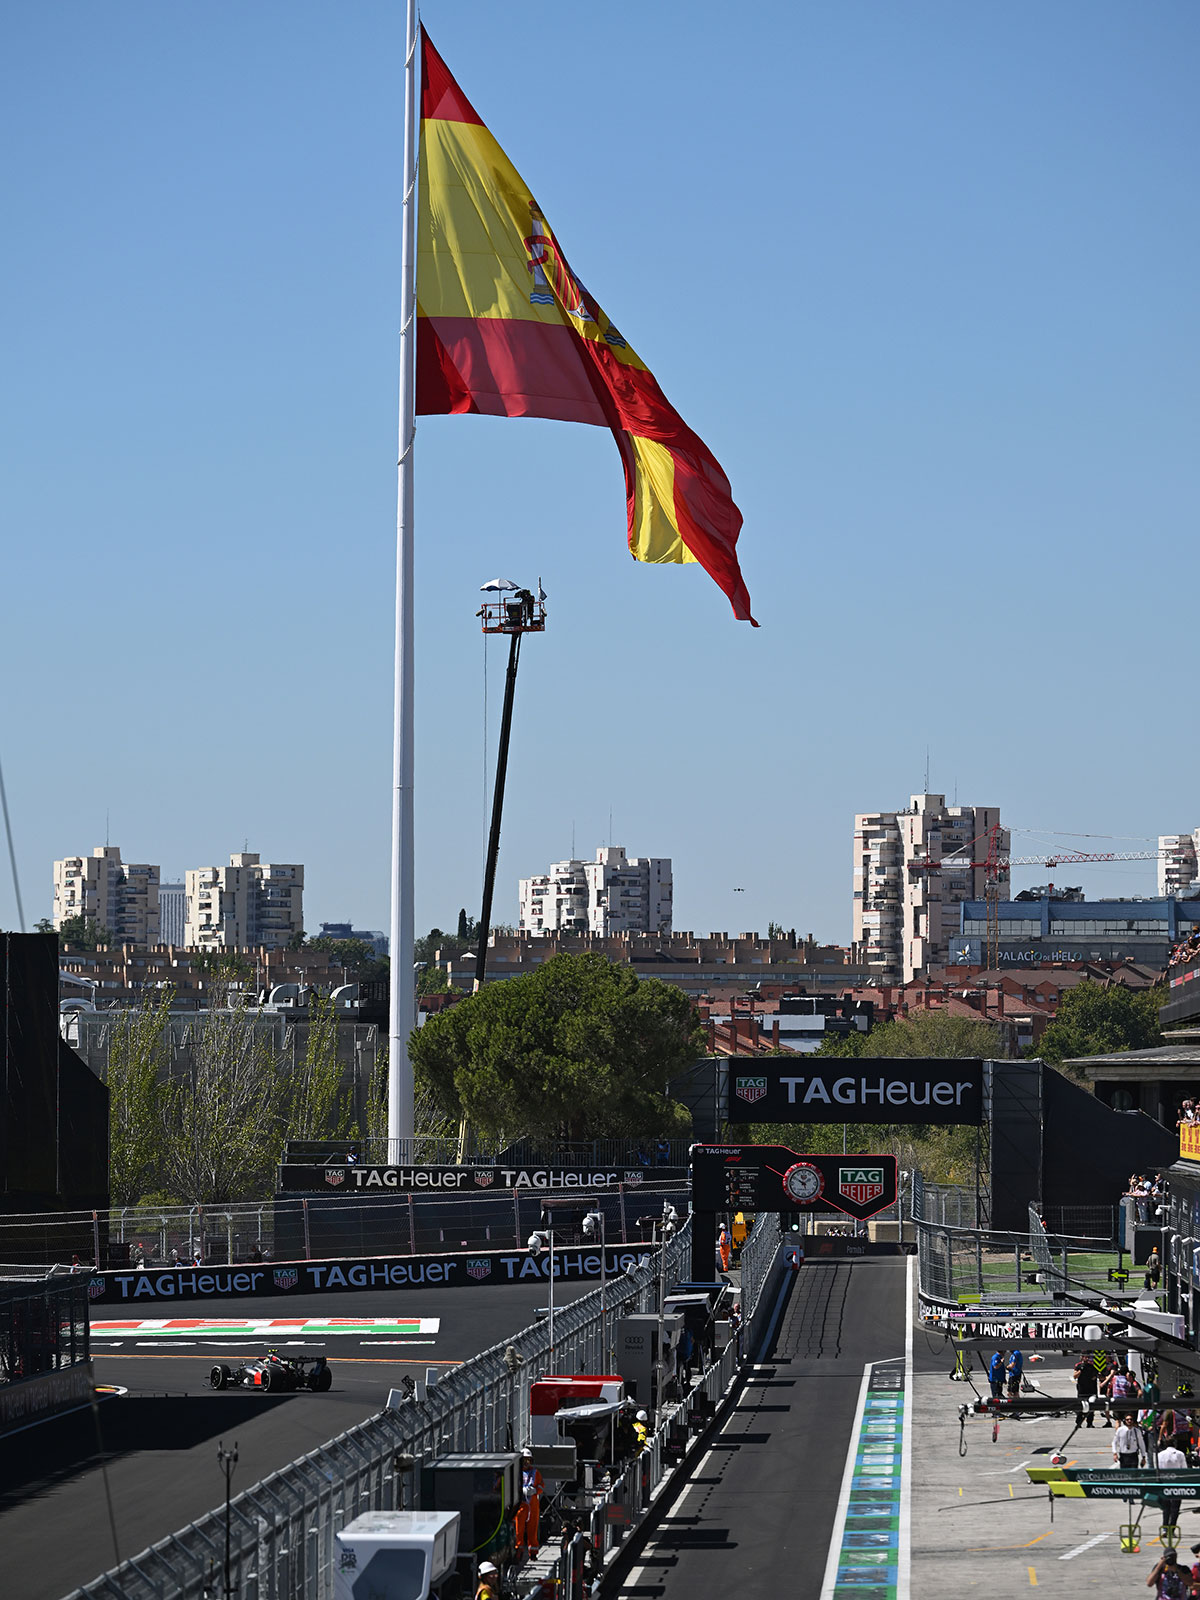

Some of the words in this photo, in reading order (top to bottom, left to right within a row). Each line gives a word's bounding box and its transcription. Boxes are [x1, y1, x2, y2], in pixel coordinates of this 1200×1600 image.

[738, 1079, 765, 1087] TAG
[737, 1089, 766, 1101] HEUER
[843, 1171, 880, 1182] TAG
[842, 1185, 881, 1203] HEUER
[275, 1269, 296, 1277] TAG
[1091, 1487, 1114, 1495] ASTON
[1114, 1487, 1141, 1495] MARTIN
[1163, 1488, 1197, 1496] aramco
